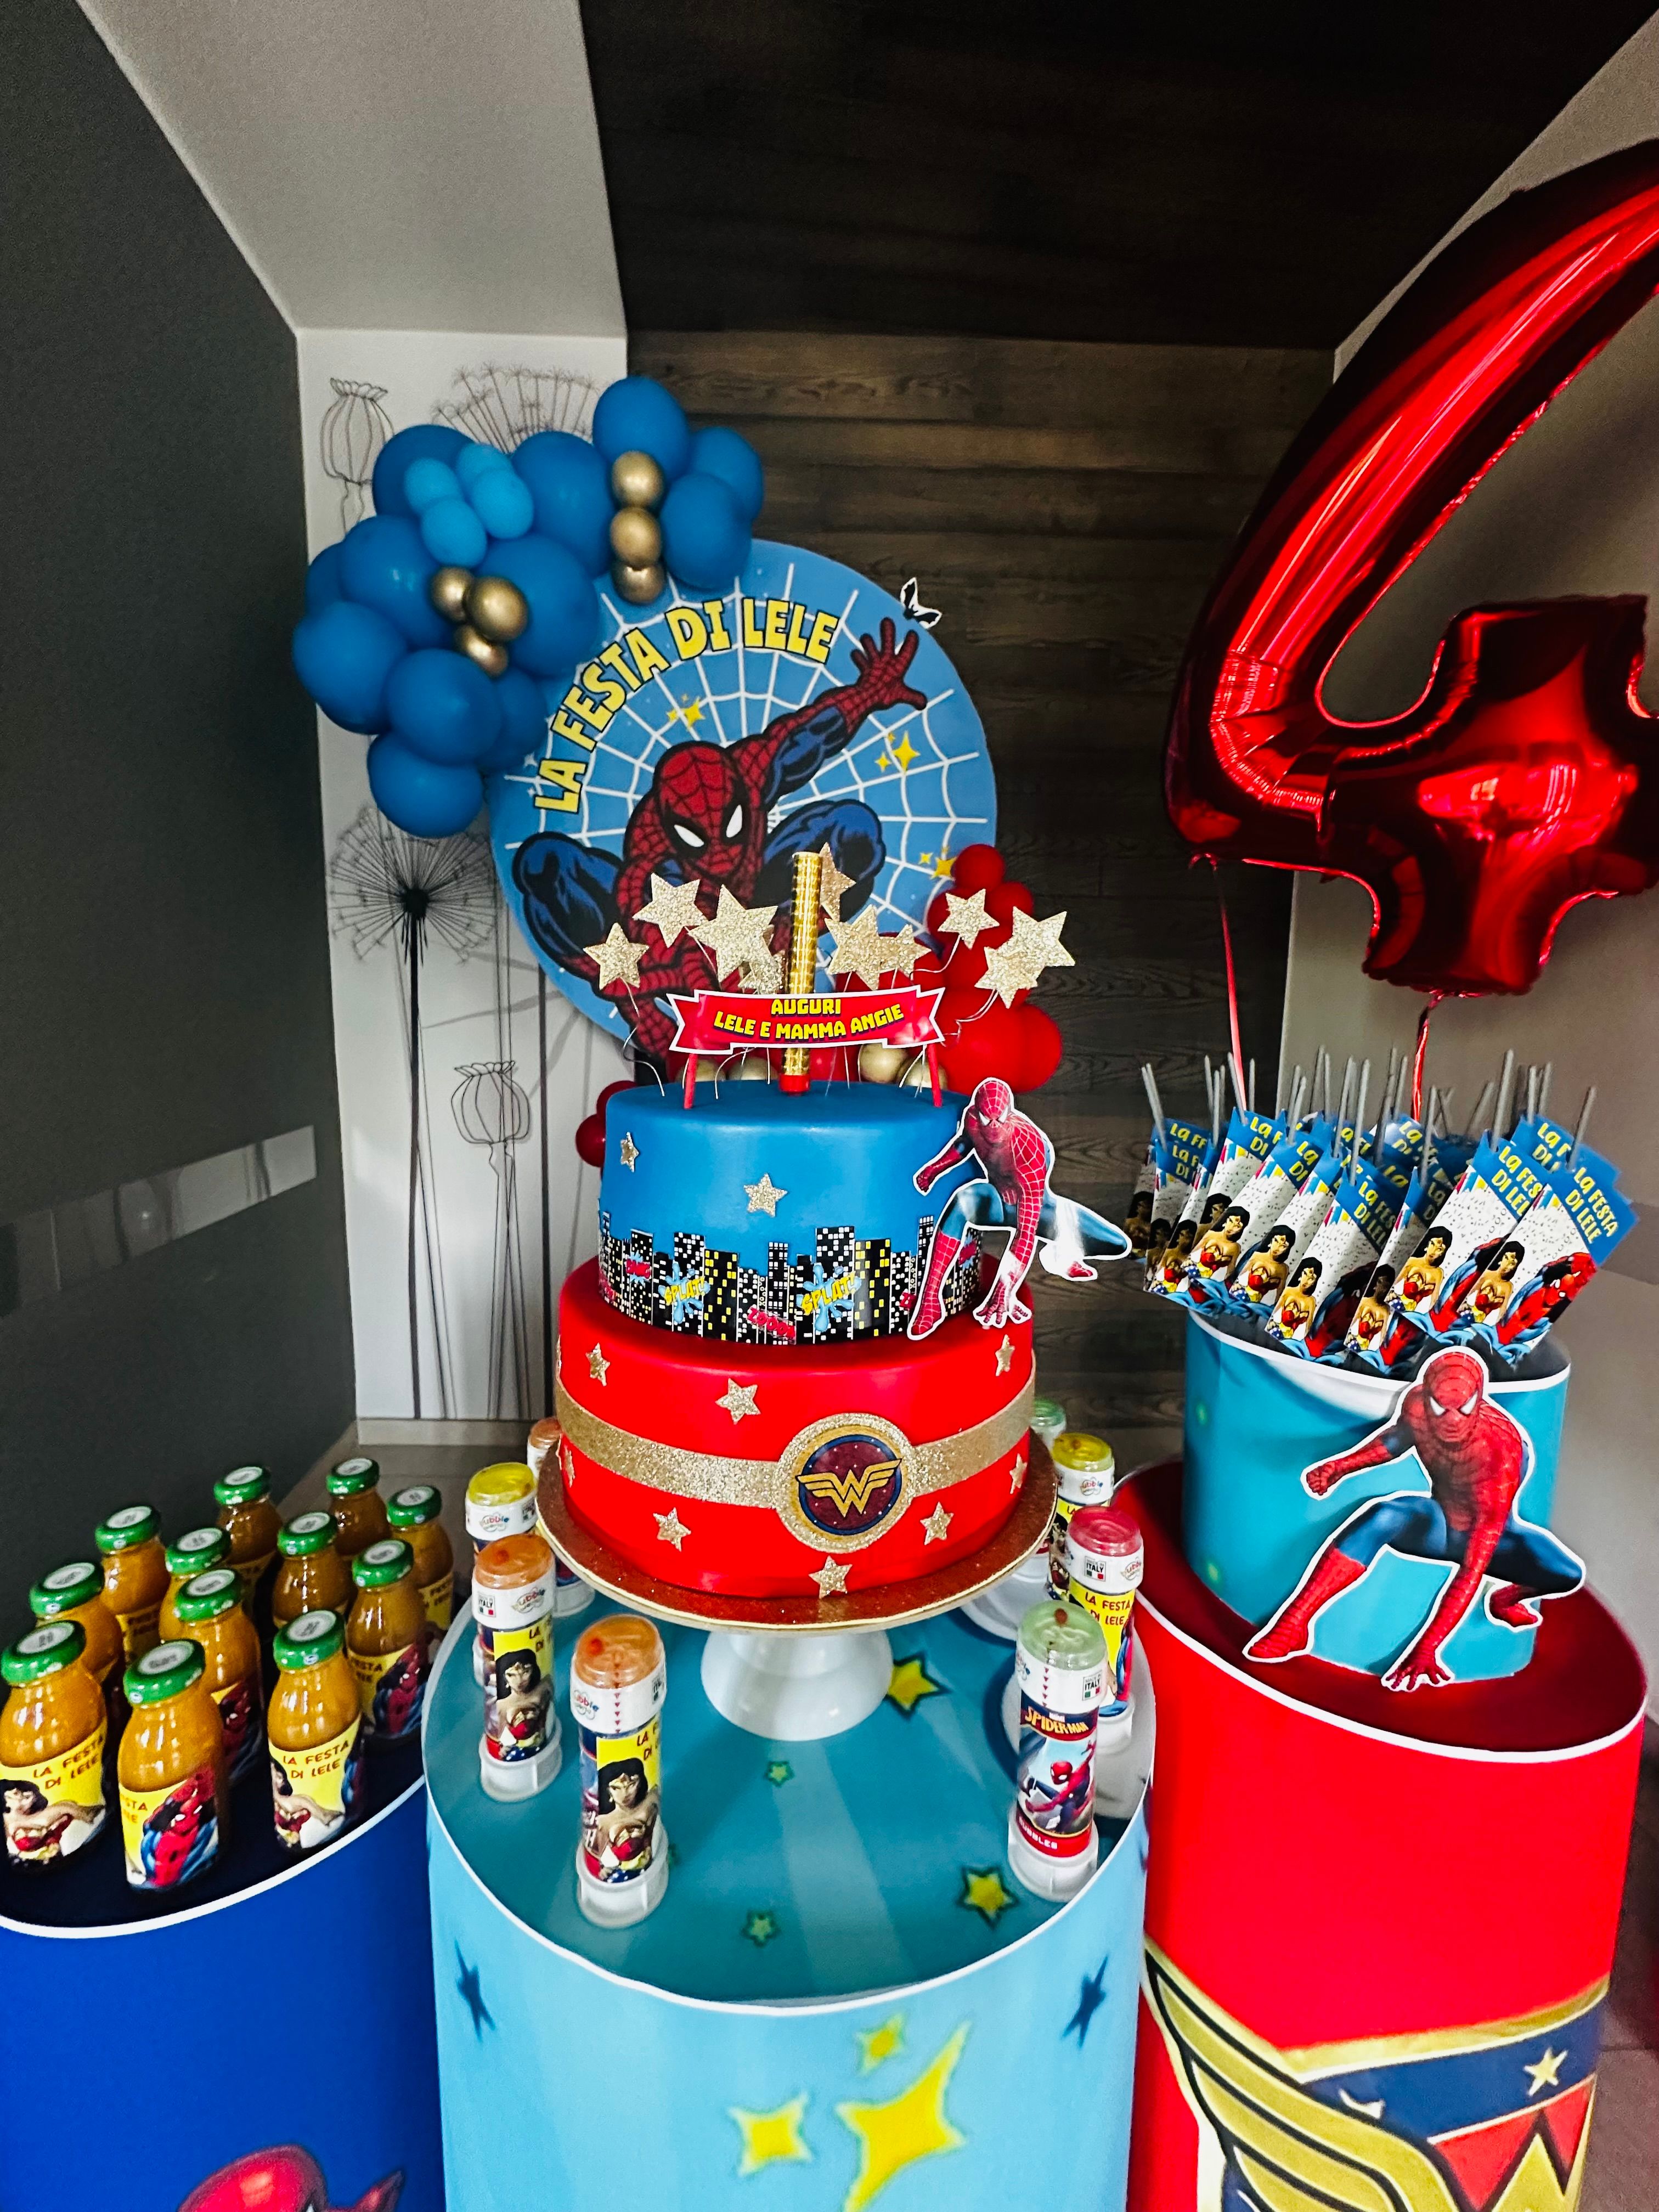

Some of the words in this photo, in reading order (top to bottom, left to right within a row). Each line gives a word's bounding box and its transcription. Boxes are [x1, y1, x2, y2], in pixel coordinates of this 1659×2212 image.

[665, 605, 732, 661] DI
[742, 597, 840, 664] LELE
[551, 627, 669, 753] FESTA
[535, 757, 586, 814] LA
[771, 998, 842, 1016] AUGURI
[714, 1011, 757, 1036] LELE
[760, 1022, 771, 1037] E
[775, 1020, 847, 1040] MAMMA
[850, 1003, 905, 1034] ANGIE
[1250, 1136, 1269, 1156] DI
[1532, 1144, 1552, 1166] DI
[1176, 1163, 1189, 1179] DI
[1289, 1160, 1308, 1182] DI
[1491, 1169, 1513, 1193] DI
[1505, 1186, 1531, 1217] LEL
[1516, 1167, 1543, 1198] FES
[1353, 1202, 1371, 1224] DI
[1374, 1200, 1397, 1229] FES
[1565, 1189, 1584, 1212] DI
[1577, 1207, 1602, 1244] LELE
[1588, 1189, 1618, 1237] FESTA
[664, 1276, 705, 1306] SPLAT!
[802, 1271, 856, 1316] SPLAT!
[1086, 1563, 1104, 1573] ITALY
[1085, 1592, 1096, 1605] LA
[1102, 1600, 1130, 1611] FESTA
[1105, 1616, 1125, 1626] LELE
[529, 1626, 540, 1639] LA
[1085, 1679, 1101, 1690] ITALY
[1024, 1706, 1089, 1735] SPIDER-MAN
[637, 1731, 648, 1746] LA
[283, 1756, 297, 1765] LA
[306, 1740, 349, 1764] FESTA
[33, 1767, 52, 1778] LA
[291, 1770, 303, 1779] DI
[312, 1758, 341, 1777] LELE
[45, 1776, 61, 1790] DI
